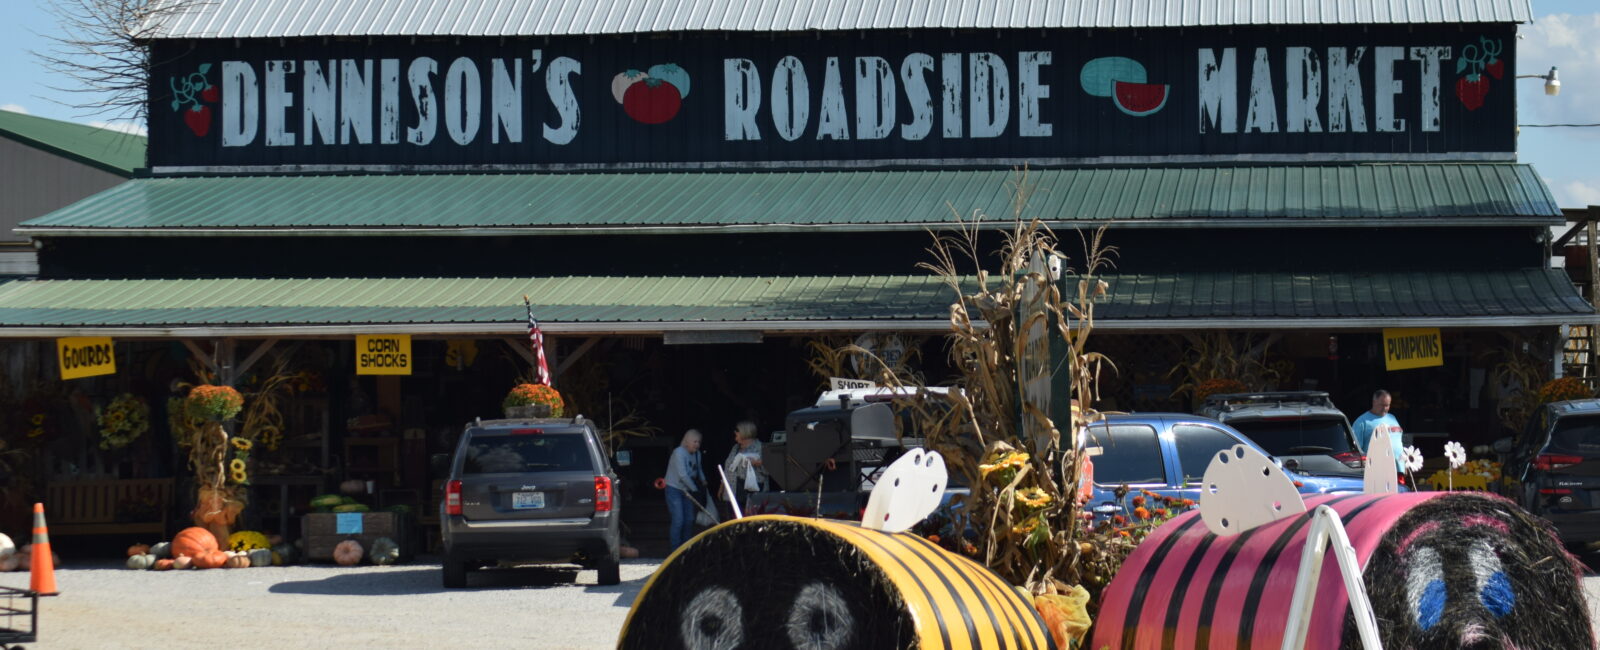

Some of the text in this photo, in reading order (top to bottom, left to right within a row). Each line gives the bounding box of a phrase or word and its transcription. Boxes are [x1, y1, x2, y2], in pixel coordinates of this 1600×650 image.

[222, 46, 1451, 147] DENNISON'S ROADSIDE MARKET
[63, 344, 111, 369] GOURDS
[368, 339, 399, 352] CORN
[1388, 333, 1438, 361] PUMPKINS
[361, 353, 407, 367] SHOCKS
